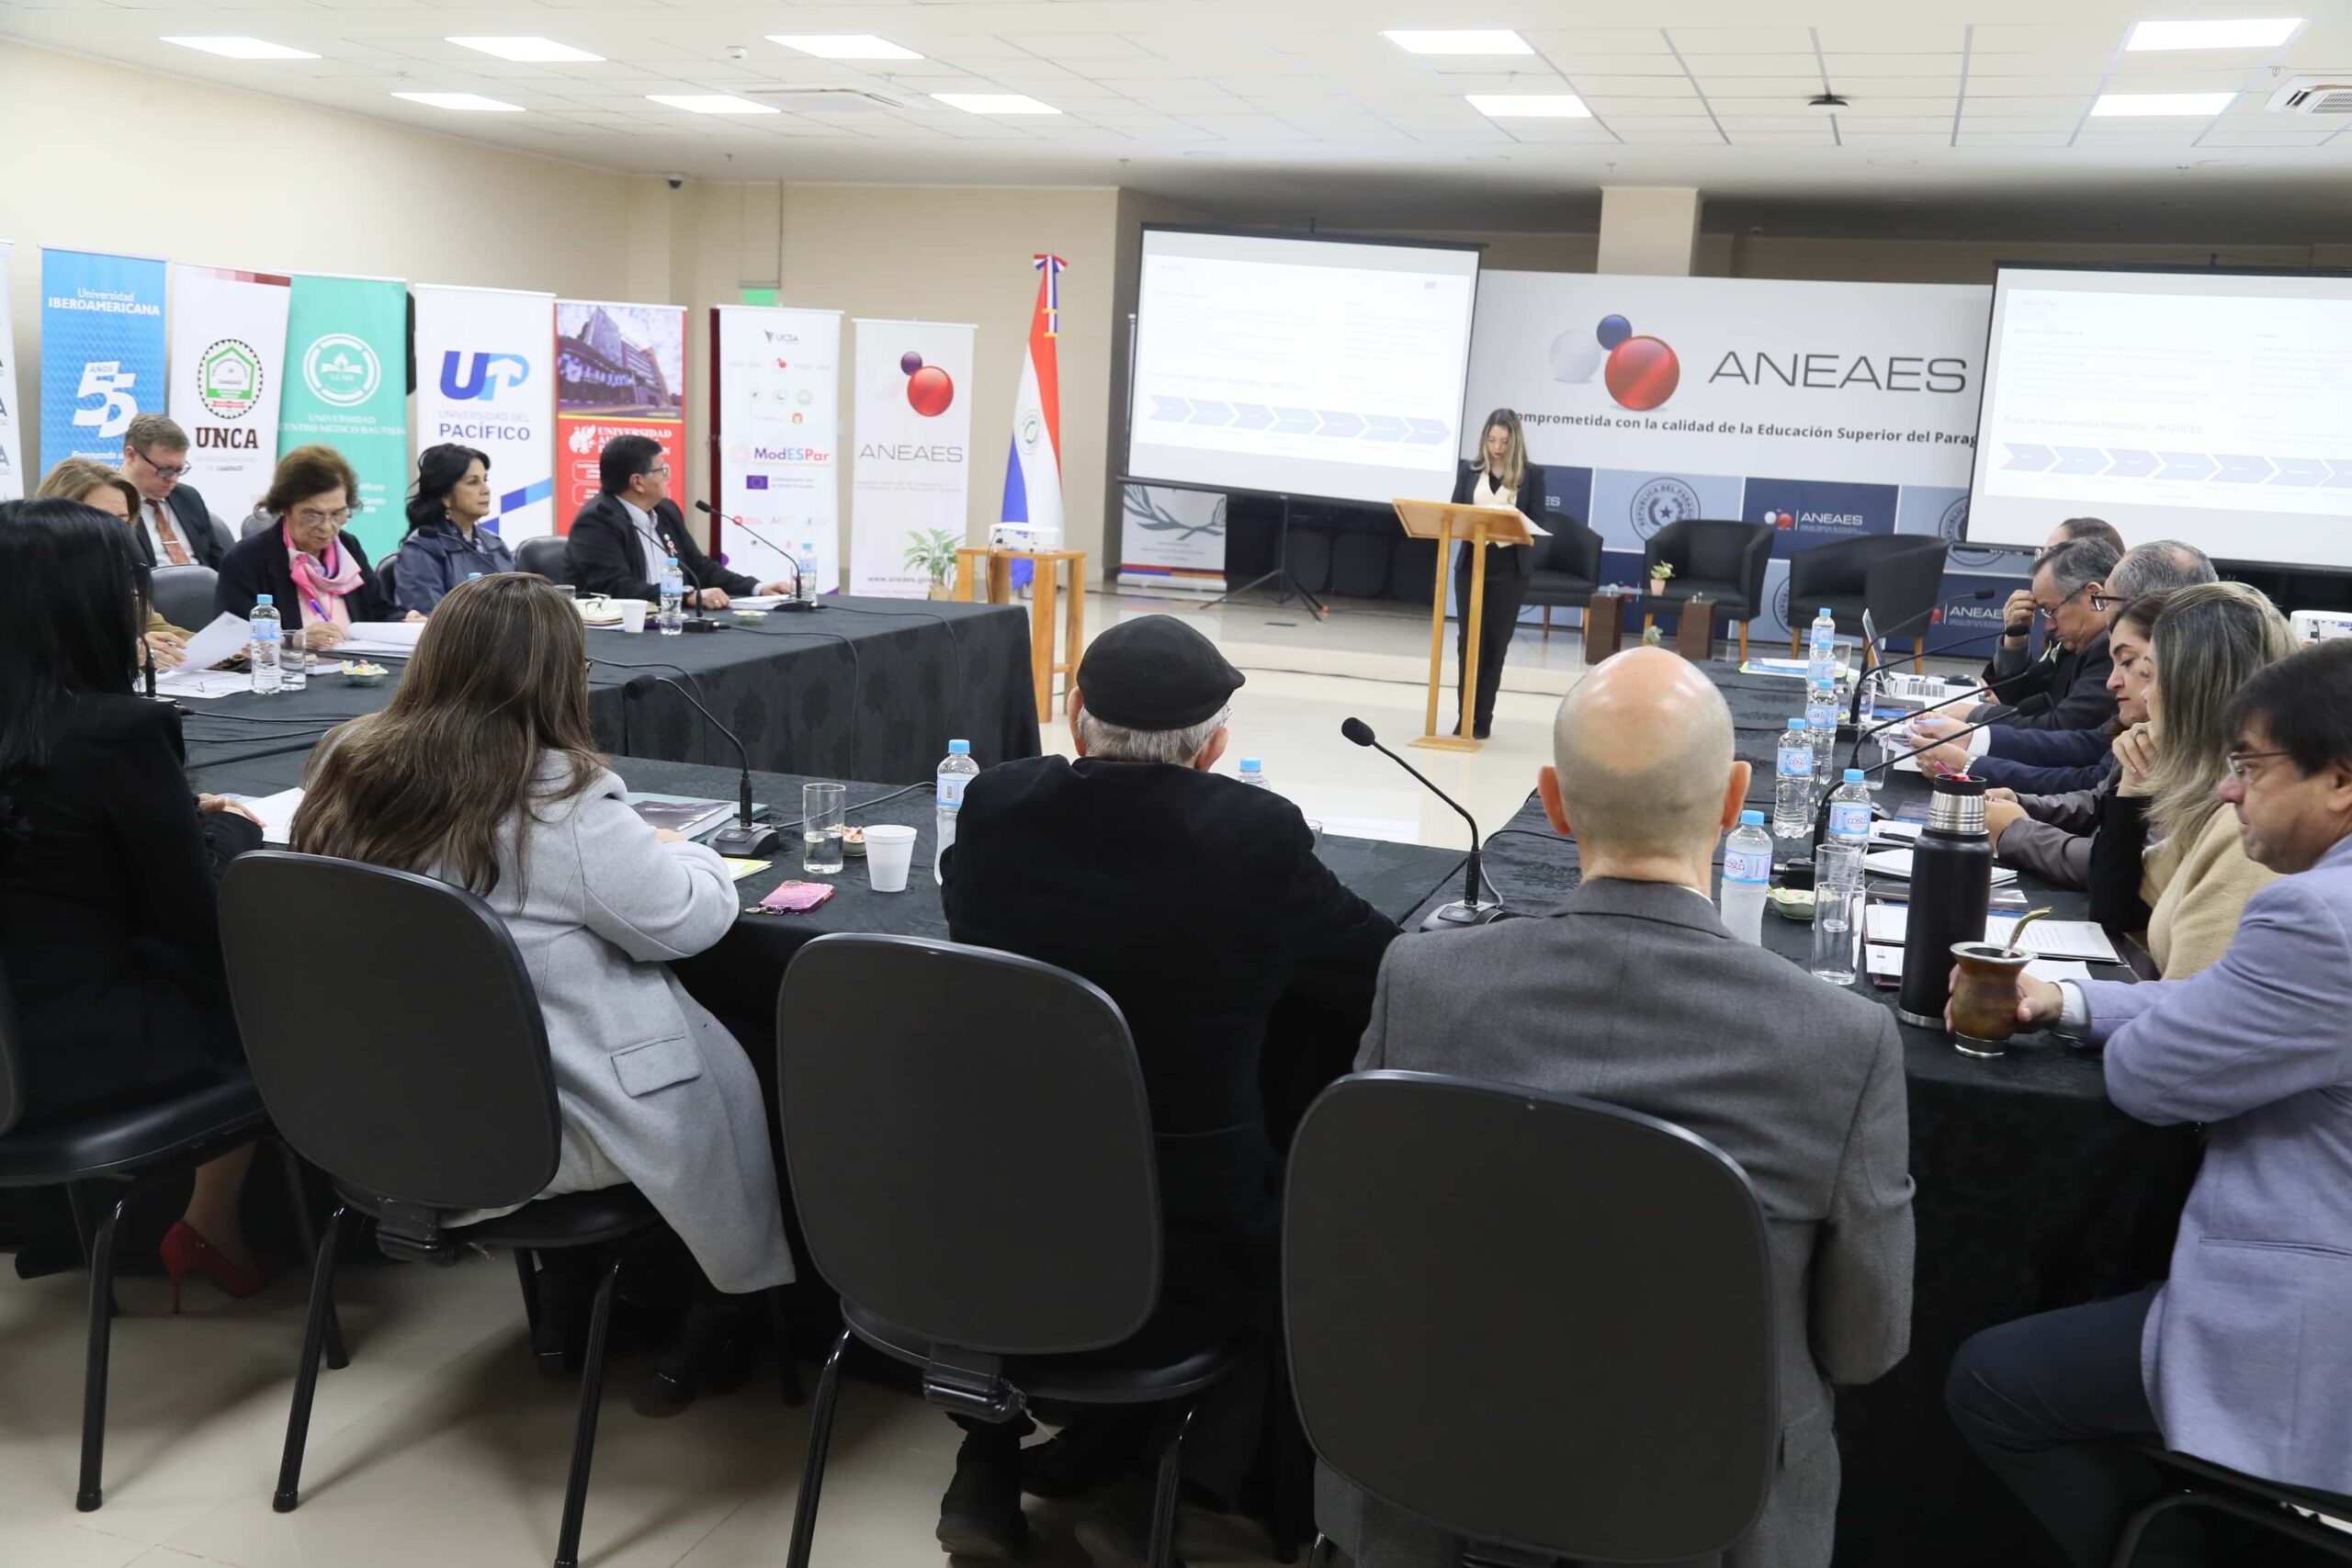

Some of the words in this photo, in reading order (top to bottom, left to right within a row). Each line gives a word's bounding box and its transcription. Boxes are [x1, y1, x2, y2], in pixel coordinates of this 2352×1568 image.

[77, 287, 135, 302] Universidad
[48, 296, 161, 316] IBEROAMERICANA
[1708, 350, 1968, 393] ANEAES
[438, 409, 508, 423] UNIVERSIDAD
[196, 426, 259, 449] UNCA
[438, 420, 531, 442] PACÍFICO
[1518, 412, 1611, 428] omprometida
[1615, 417, 1641, 429] con
[1645, 417, 1658, 430] la
[1661, 419, 1714, 434] calidad
[1717, 421, 1736, 434] de
[1739, 422, 1753, 434] la
[1757, 423, 1833, 439] Educación
[1837, 426, 1903, 443] Superior
[1905, 429, 1930, 443] del
[1934, 431, 1977, 449] Parag
[753, 446, 831, 461] ModESPar
[859, 444, 964, 463] ANEAES
[1801, 512, 1864, 526] ANEAES
[1949, 606, 2003, 619] ANEAE
